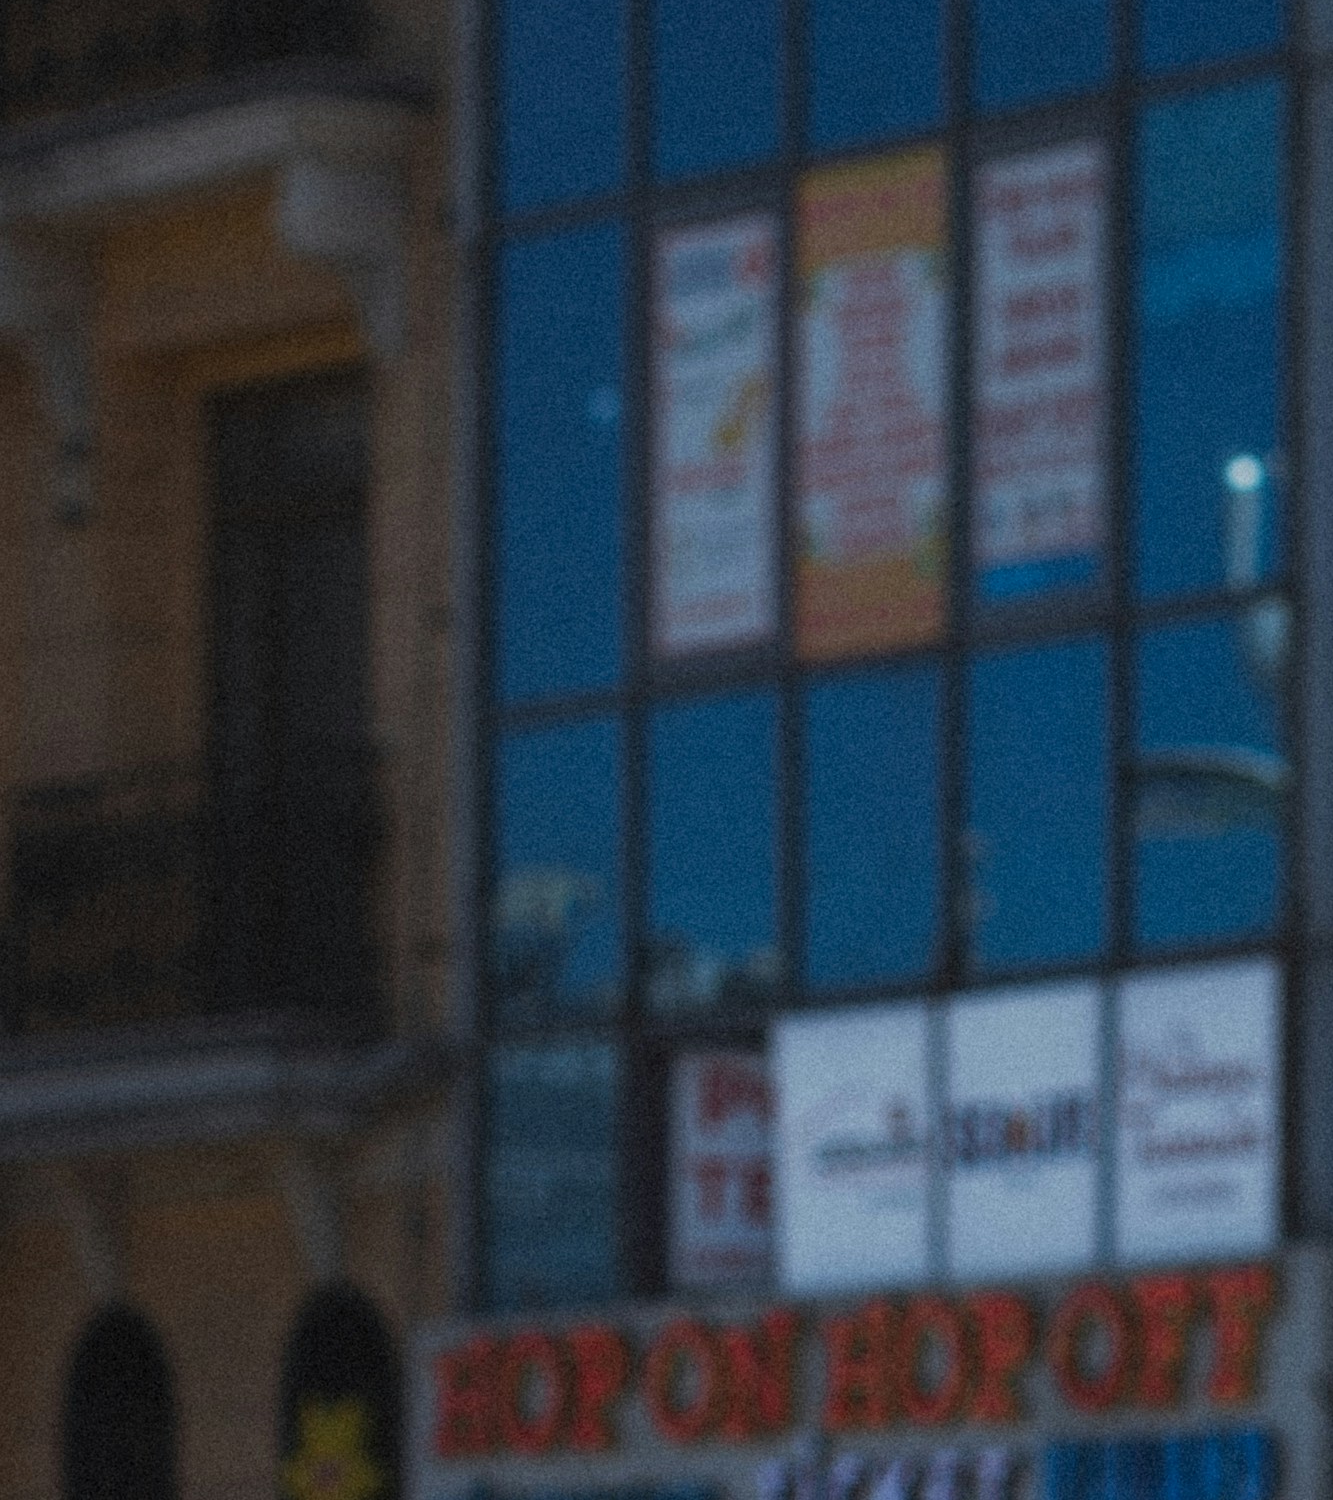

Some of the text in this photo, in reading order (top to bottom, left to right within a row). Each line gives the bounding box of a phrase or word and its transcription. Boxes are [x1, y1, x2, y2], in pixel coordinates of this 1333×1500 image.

[437, 1264, 1278, 1454] HOP ON HOP OFF
